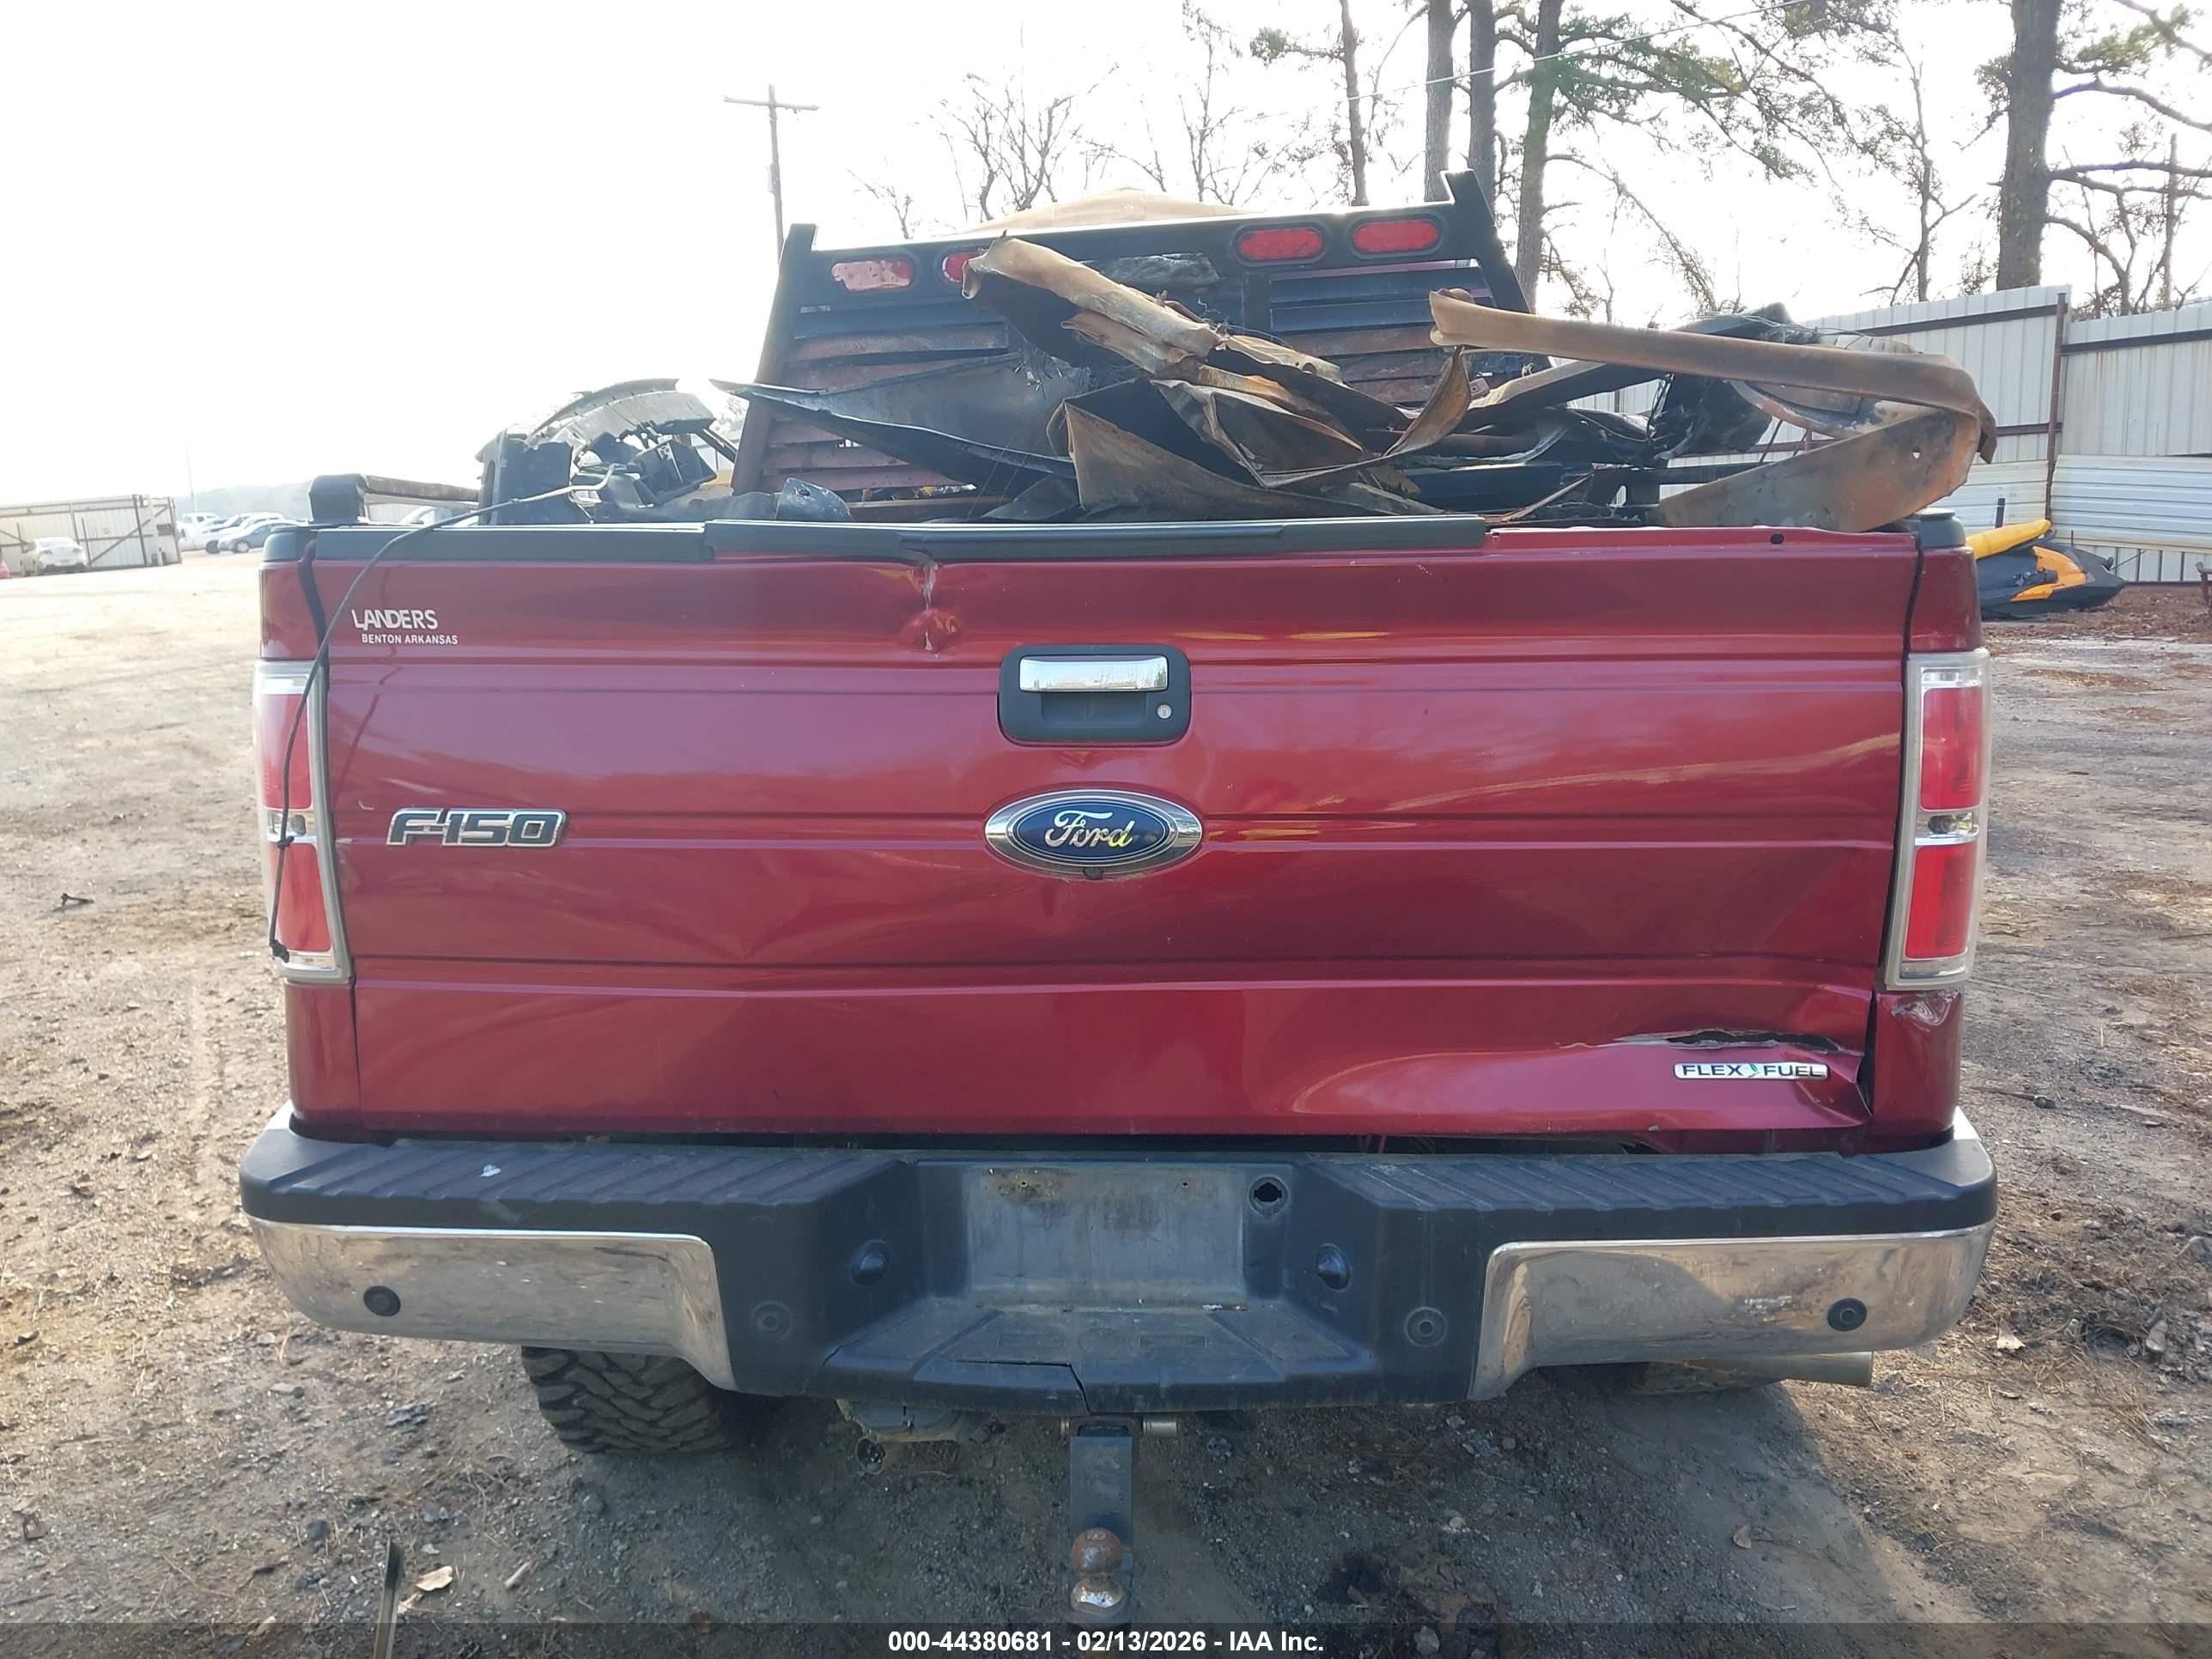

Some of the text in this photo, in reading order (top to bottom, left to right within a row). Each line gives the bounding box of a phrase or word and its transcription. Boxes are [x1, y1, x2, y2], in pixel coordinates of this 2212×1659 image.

[351, 609, 439, 631] LANDERS
[362, 633, 459, 646] BENTON ARKANSAS
[1044, 809, 1135, 848] Ford
[1681, 1064, 1826, 1079] FLEX FUEL
